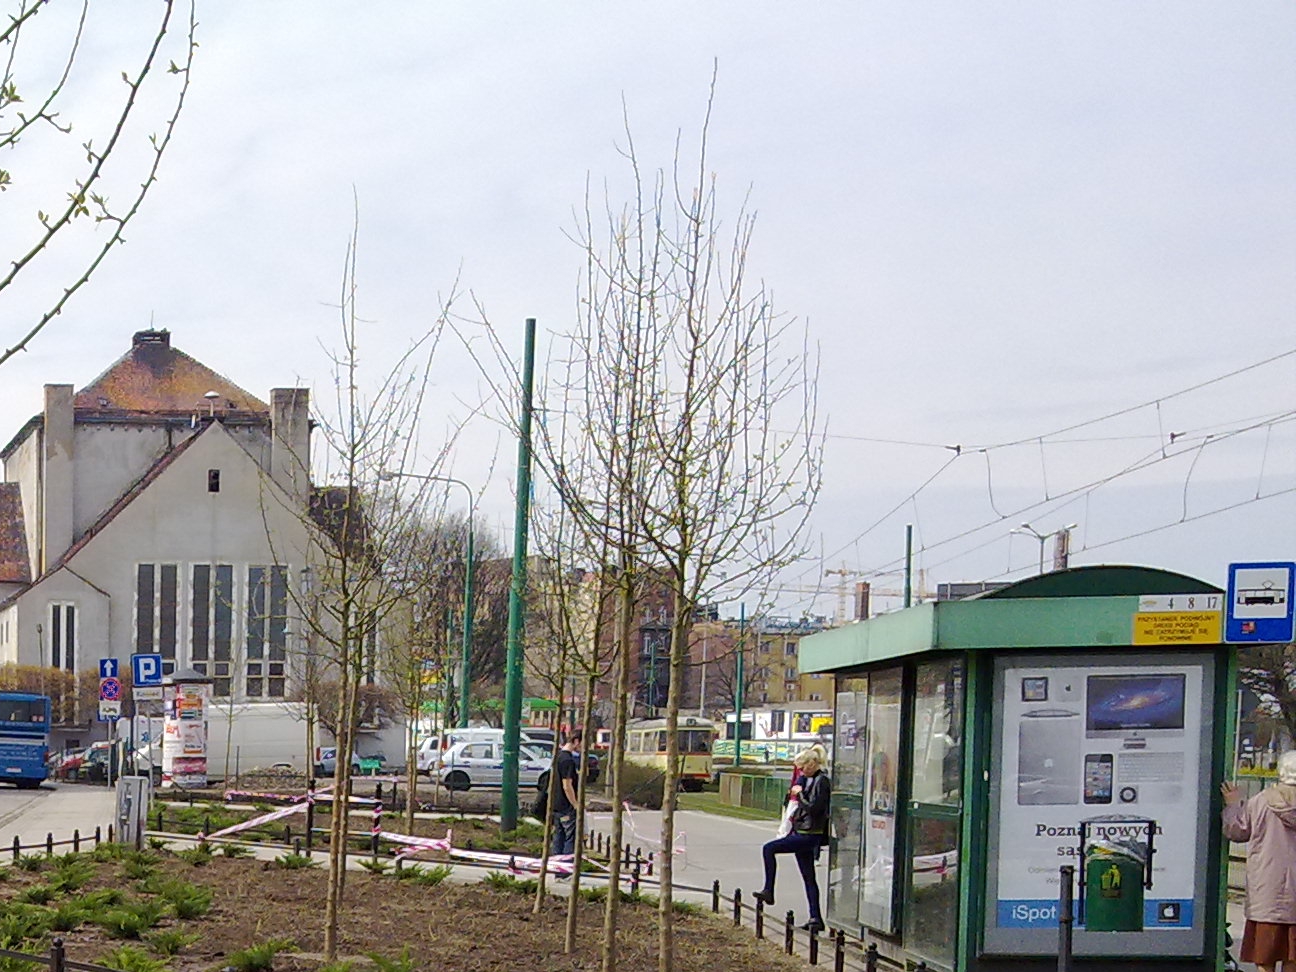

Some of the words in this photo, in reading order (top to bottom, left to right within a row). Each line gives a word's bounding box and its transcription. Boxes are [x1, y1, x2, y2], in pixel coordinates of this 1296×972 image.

[1168, 597, 1174, 609] 4
[1188, 597, 1195, 609] 8
[1207, 596, 1218, 609] 17
[138, 658, 156, 682] P
[1012, 904, 1057, 923] iSpot
